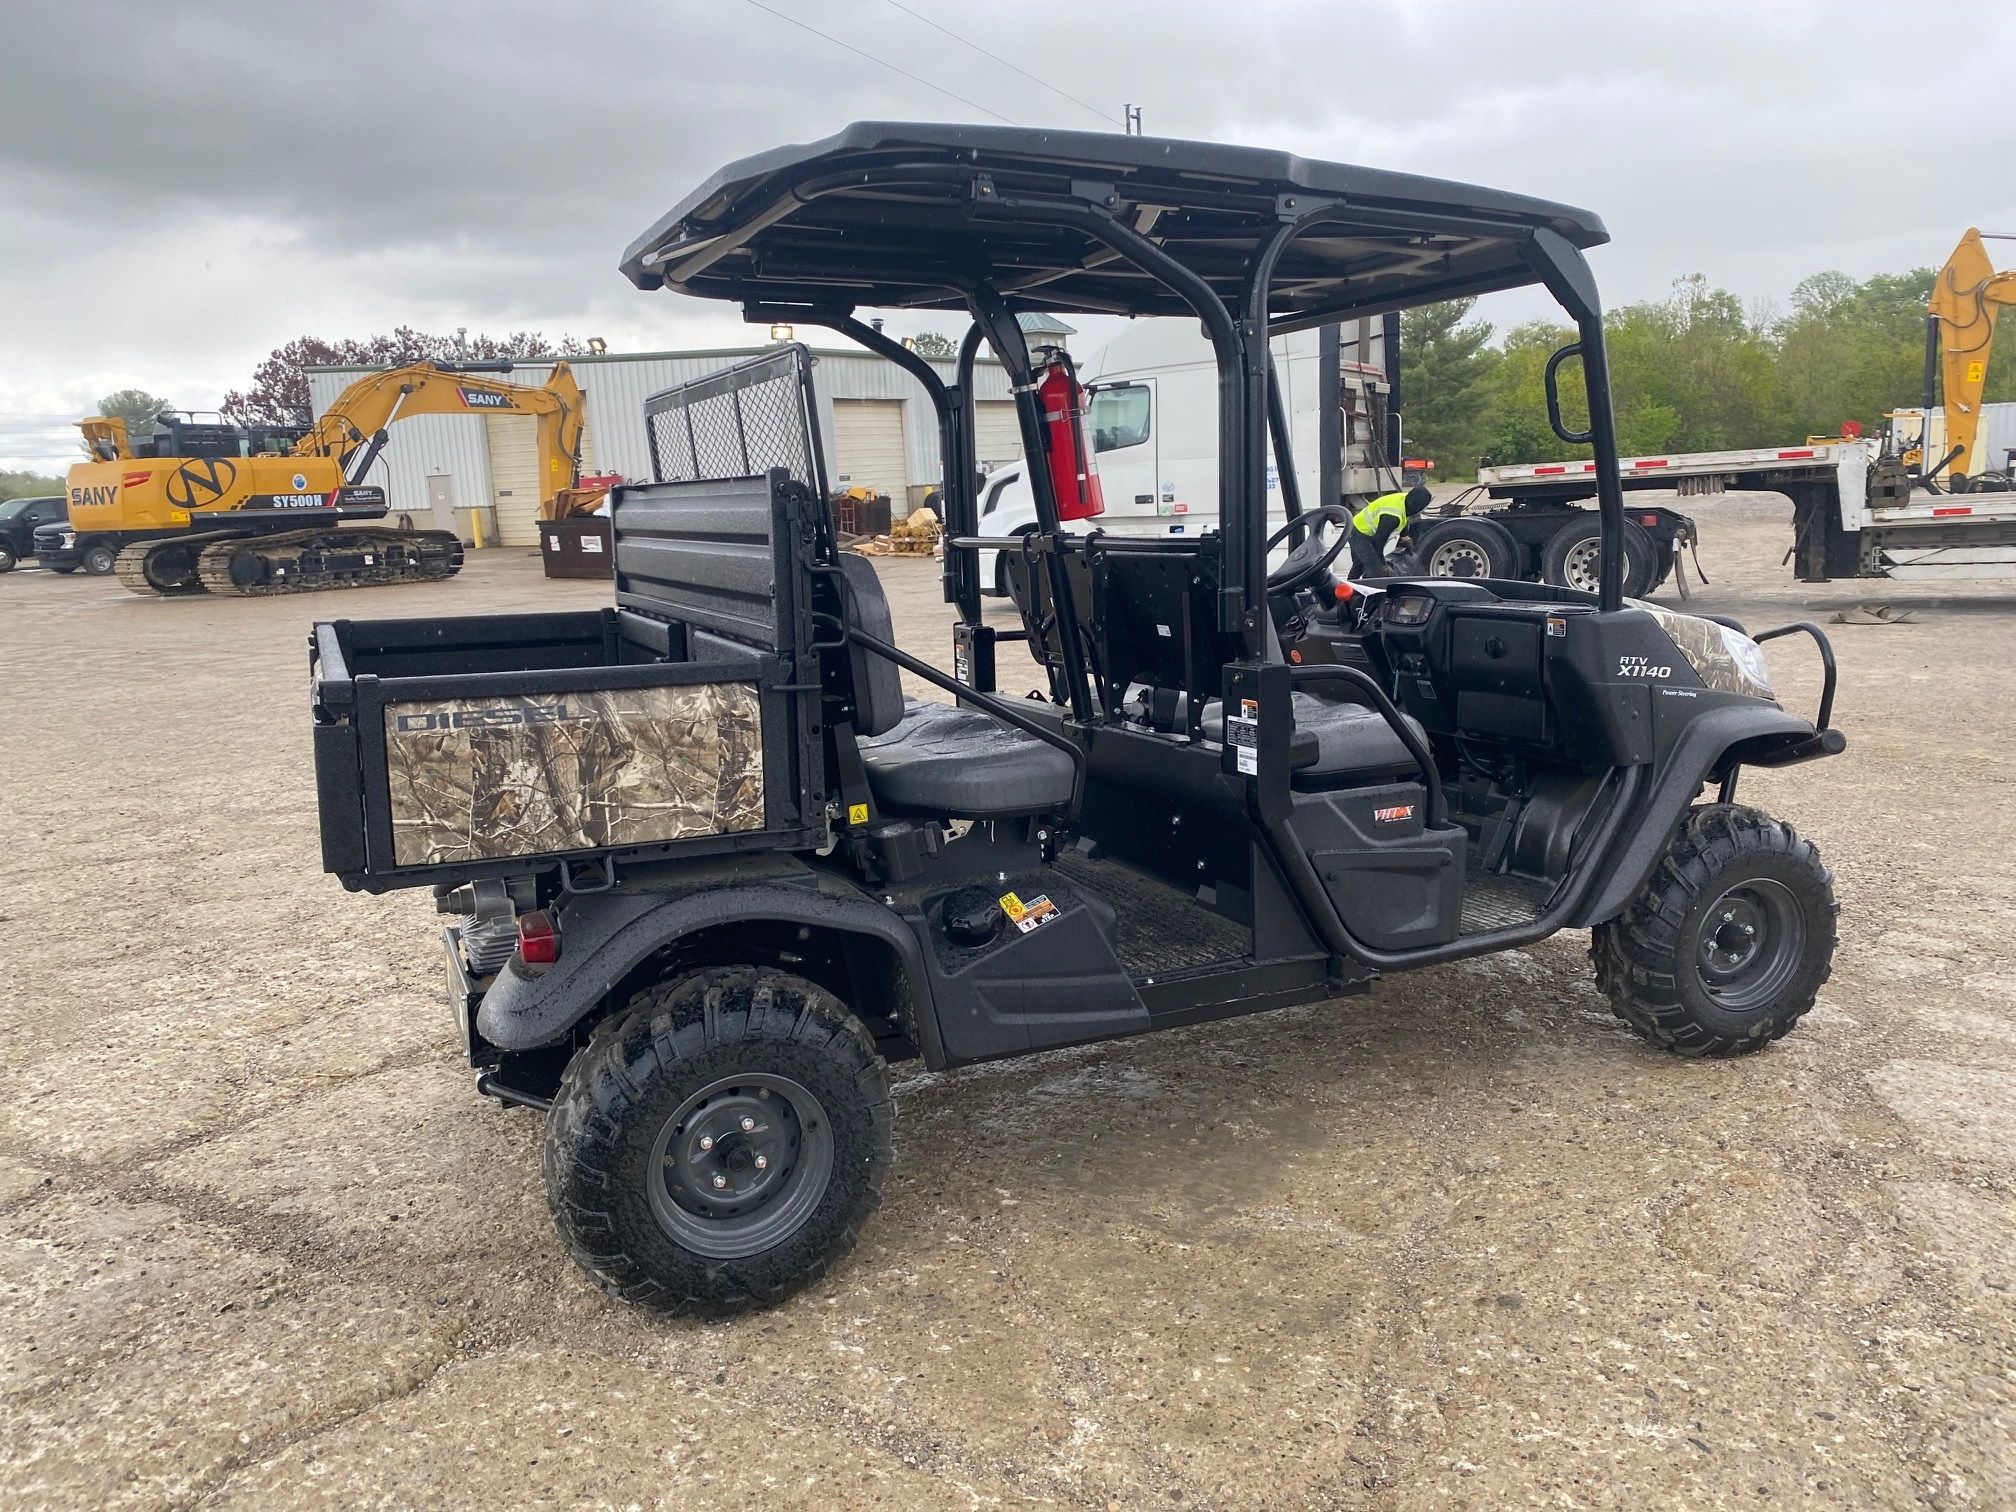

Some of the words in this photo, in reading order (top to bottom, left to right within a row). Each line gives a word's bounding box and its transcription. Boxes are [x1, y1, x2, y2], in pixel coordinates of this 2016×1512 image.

[467, 393, 503, 406] SANY
[71, 485, 118, 507] SANY
[272, 494, 323, 508] SY500H
[1619, 656, 1648, 665] RTV
[1616, 665, 1672, 678] X1140
[1678, 690, 1697, 698] Steering
[397, 705, 592, 732] DIESEL
